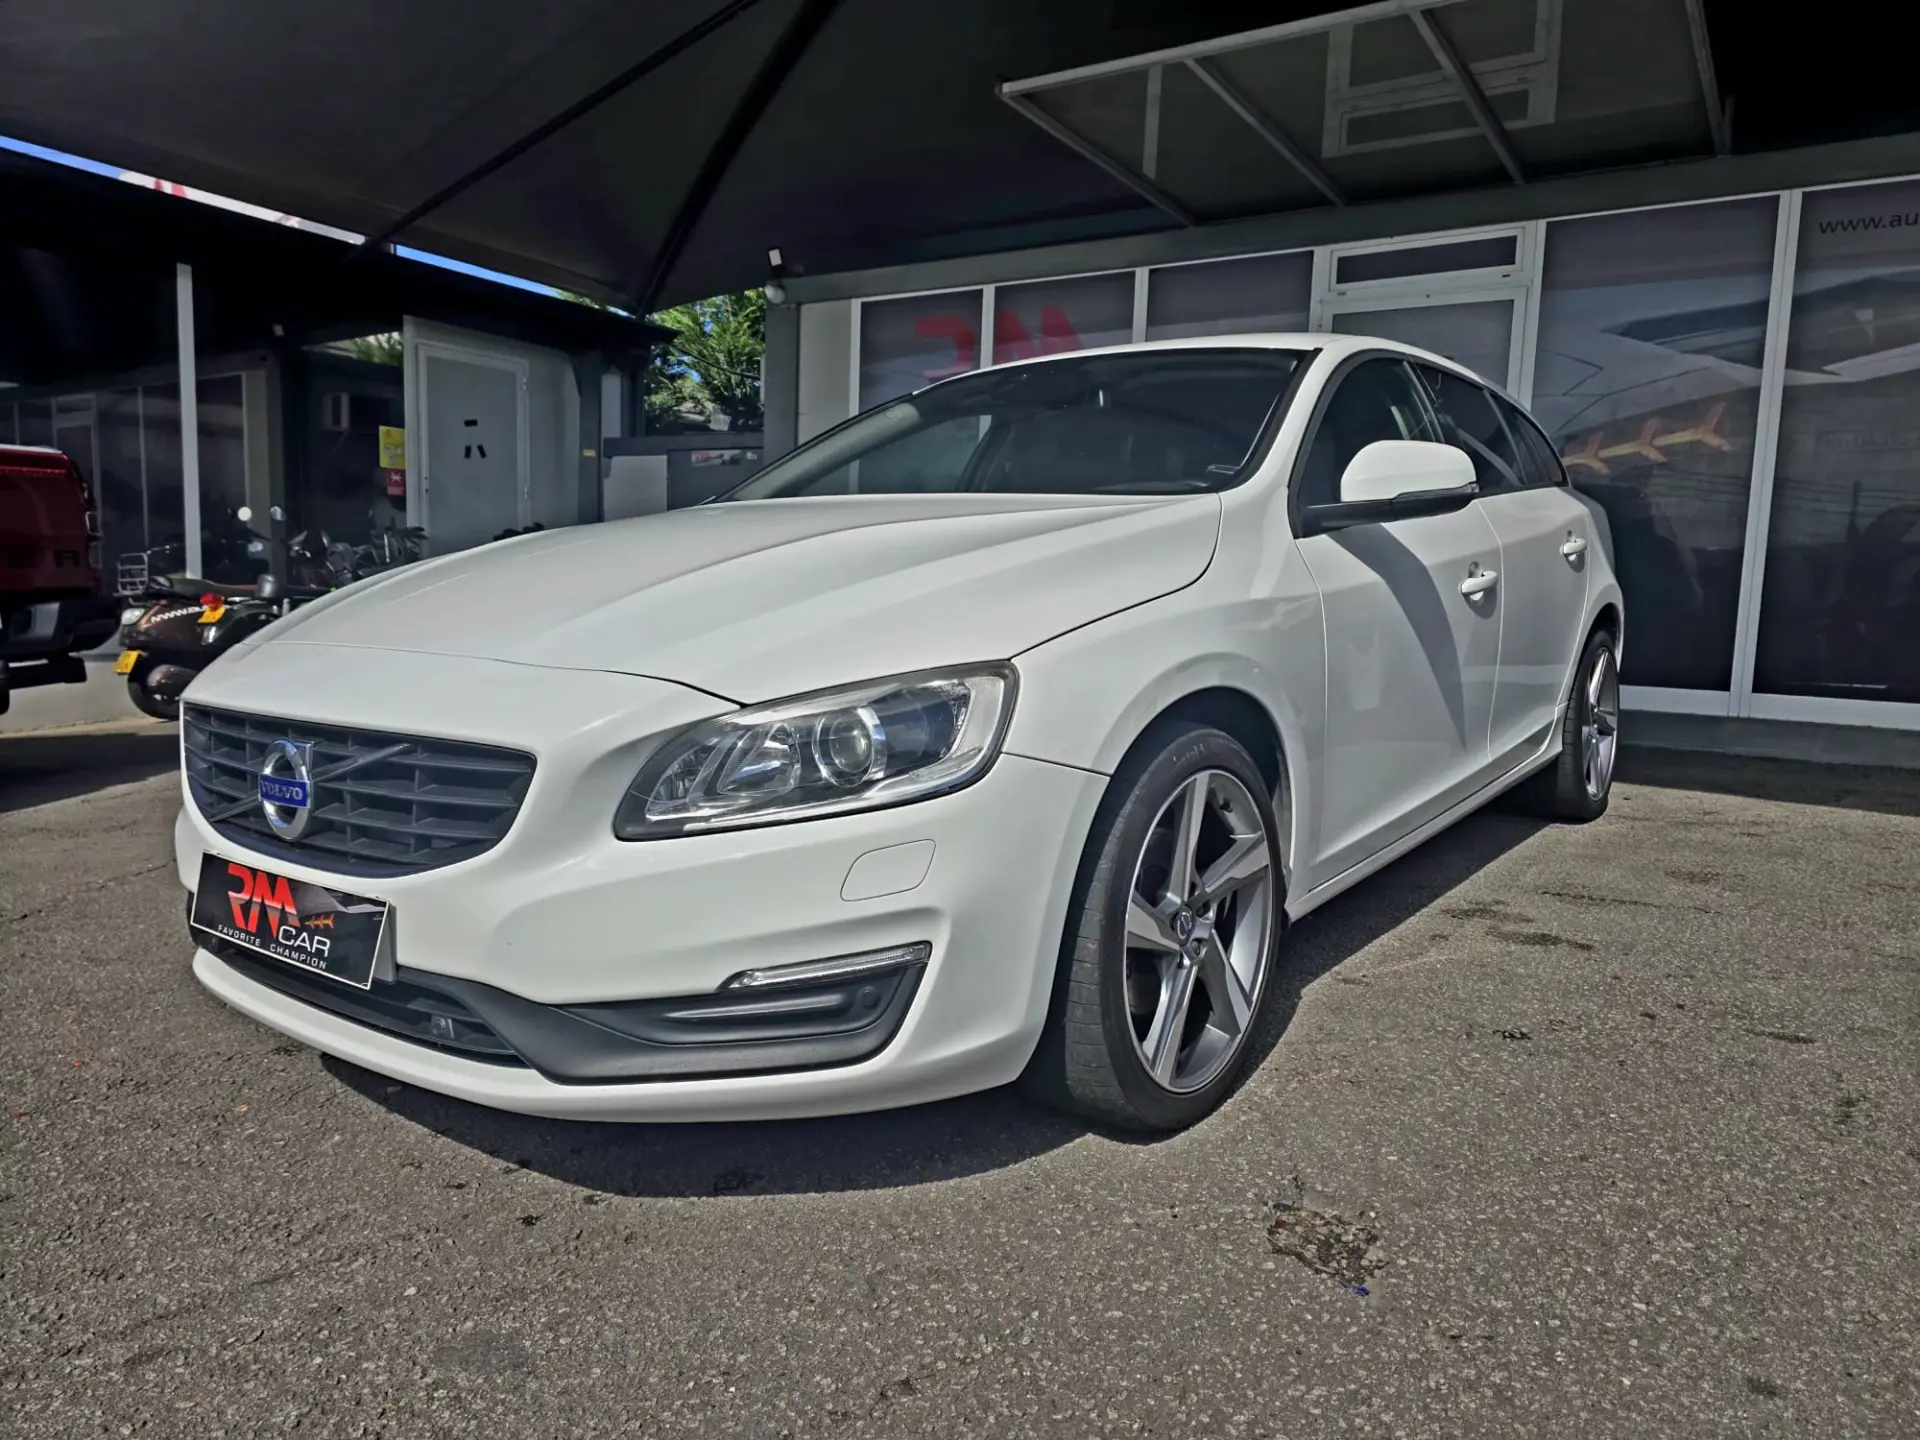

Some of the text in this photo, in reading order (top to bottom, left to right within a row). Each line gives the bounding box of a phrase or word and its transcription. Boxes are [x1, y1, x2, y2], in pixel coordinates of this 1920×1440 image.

[1819, 212, 1919, 234] www.au
[260, 780, 304, 801] VOLVO
[227, 862, 301, 939] RM
[217, 924, 327, 970] FAVORITE CHAMPION
[278, 925, 331, 958] CAR
